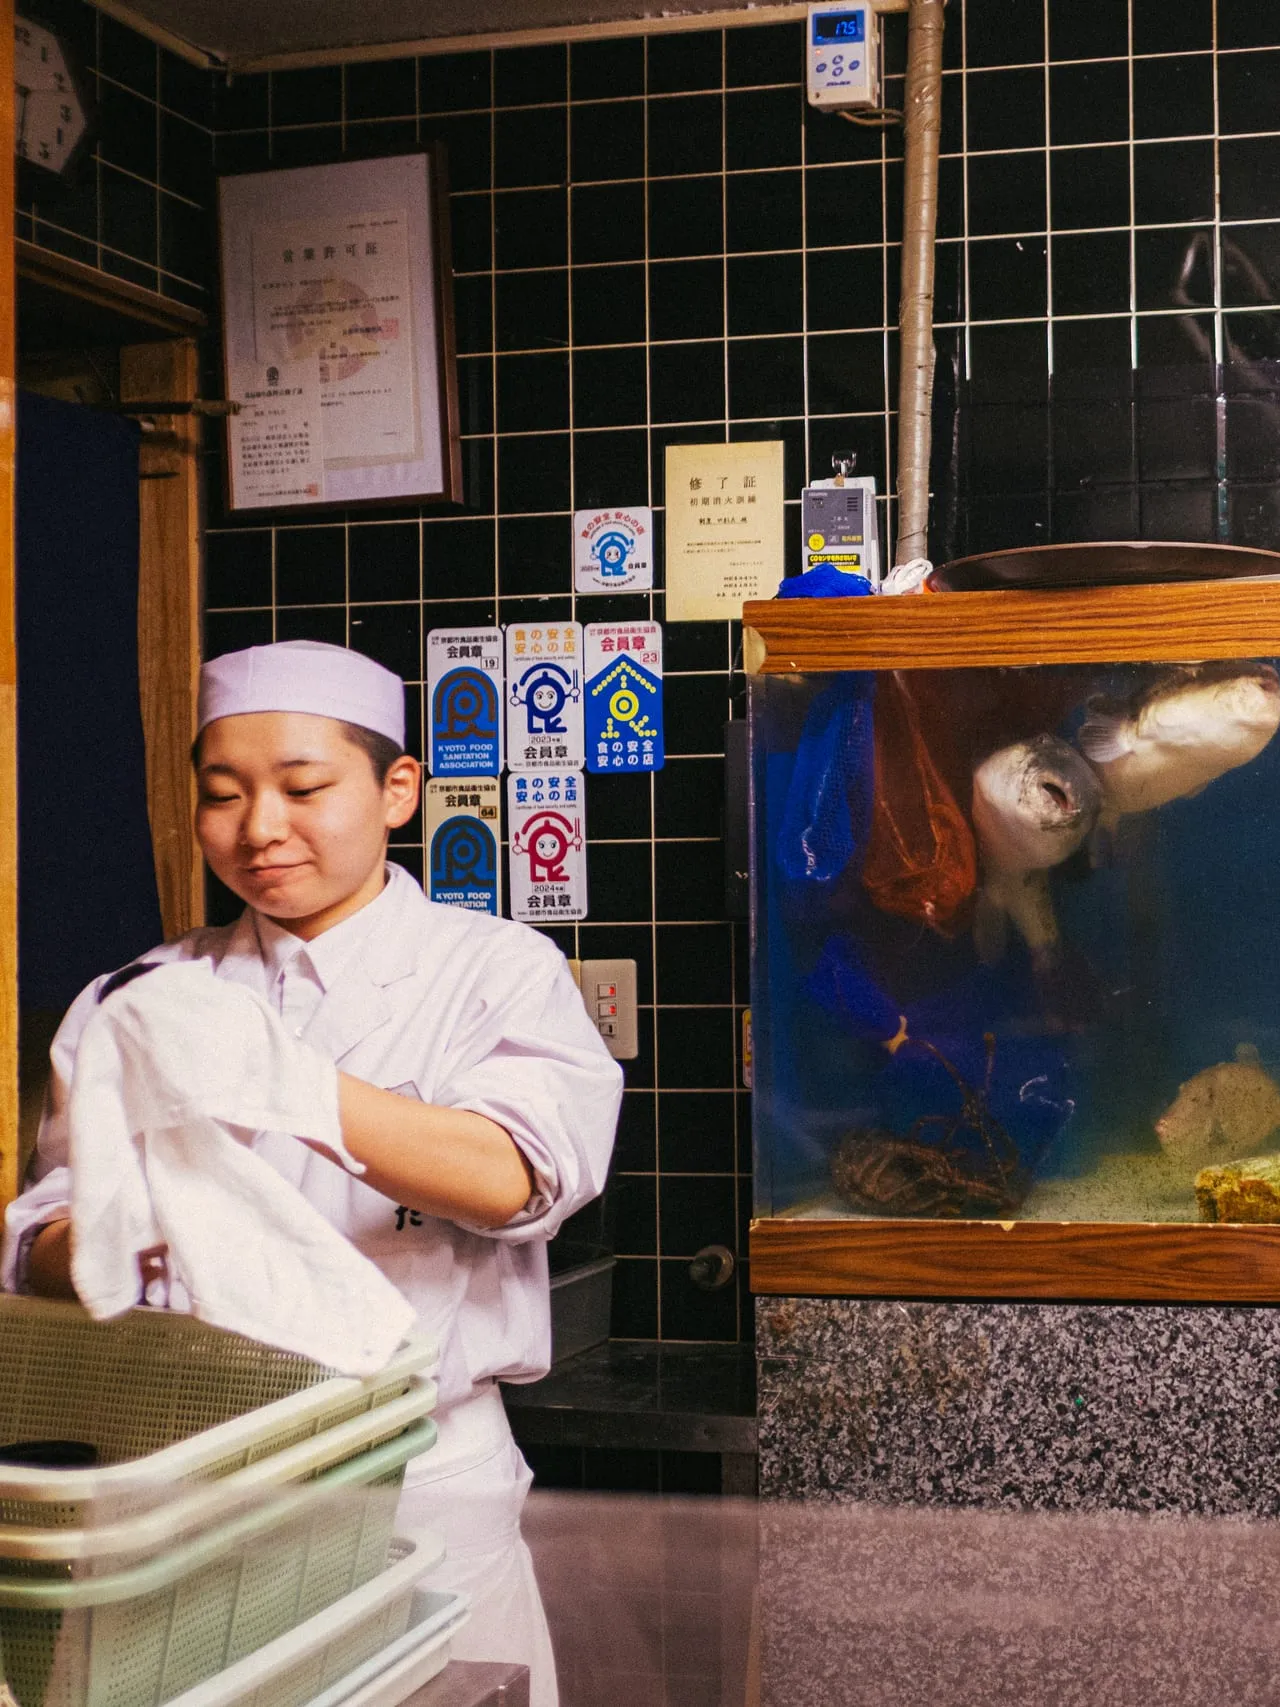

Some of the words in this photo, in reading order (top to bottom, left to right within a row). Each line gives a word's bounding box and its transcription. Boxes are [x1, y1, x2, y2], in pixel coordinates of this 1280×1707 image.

[689, 476, 757, 490] 修了証
[690, 495, 757, 506] 初期消火訓練
[515, 627, 576, 641] 食の安全
[514, 641, 576, 654] 安心の店
[600, 636, 646, 652] 会員章
[447, 645, 482, 659] 会員章
[642, 653, 658, 663] 23
[484, 659, 496, 668] 19
[438, 744, 467, 752] KYOTO
[469, 743, 493, 751] FOOD
[524, 745, 568, 759] 会員章
[597, 740, 653, 754] 食の安全
[443, 752, 490, 761] SANITATION
[597, 754, 653, 767] 安心の店
[439, 760, 494, 769] ASSOCIATION
[516, 776, 577, 790] 食の安全
[445, 794, 481, 808] 会員章
[516, 790, 577, 803] 安心の店
[480, 808, 494, 817] 64
[436, 892, 465, 900] KYOTO
[467, 892, 492, 900] FOOD
[527, 894, 571, 908] 会員章
